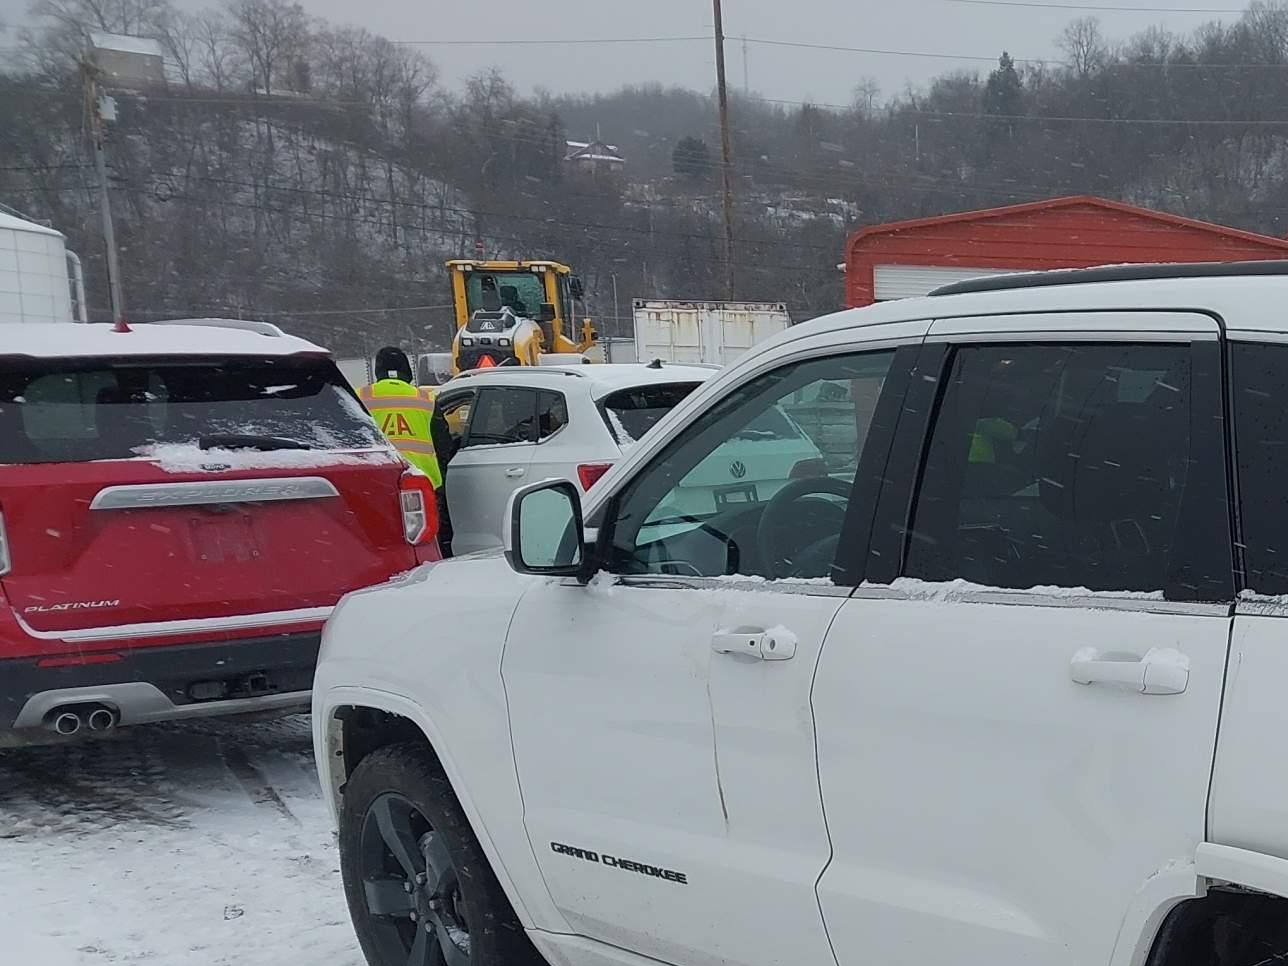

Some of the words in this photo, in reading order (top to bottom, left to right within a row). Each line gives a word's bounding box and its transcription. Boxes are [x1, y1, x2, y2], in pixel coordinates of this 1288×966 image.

[24, 600, 120, 613] PLATINUM
[550, 841, 600, 863] GRAND
[601, 854, 689, 885] CHEROKEE
